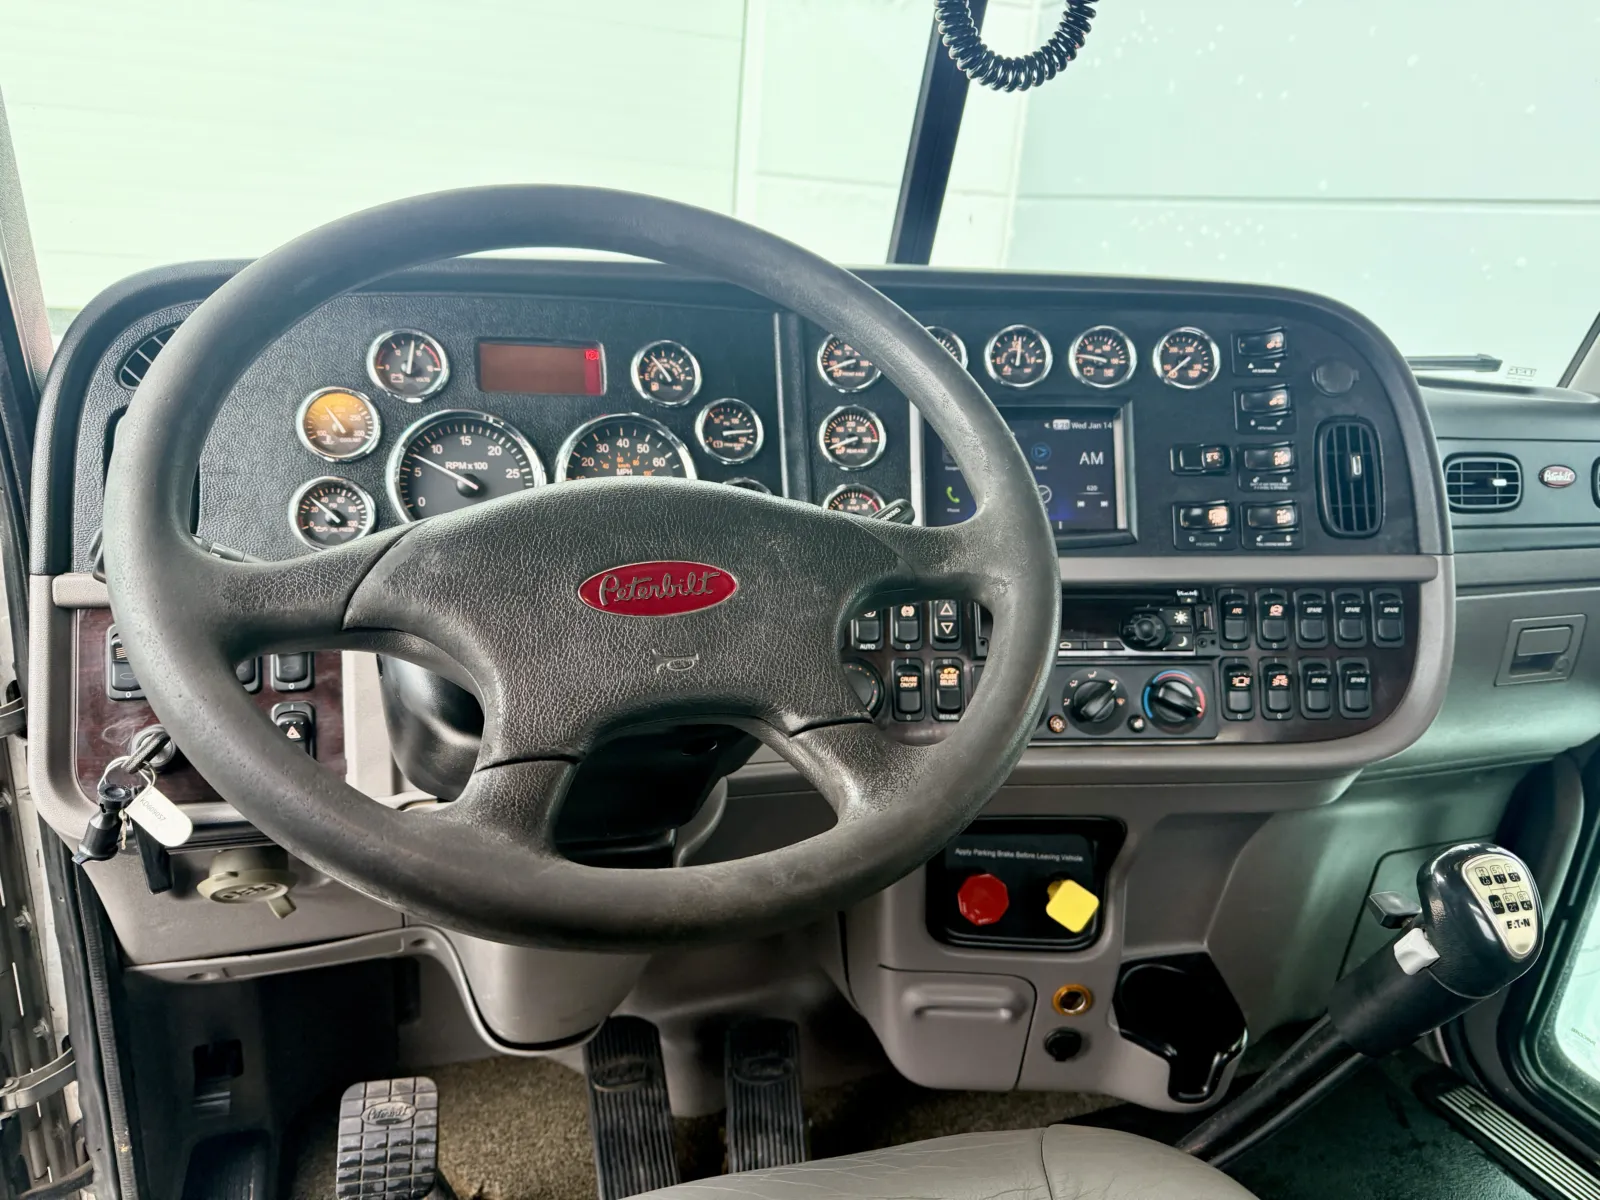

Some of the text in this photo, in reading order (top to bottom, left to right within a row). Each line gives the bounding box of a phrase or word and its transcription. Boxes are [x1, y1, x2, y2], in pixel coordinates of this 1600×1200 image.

[460, 436, 472, 446] 15
[616, 438, 630, 448] 40
[431, 444, 443, 454] 10
[487, 446, 502, 456] 20
[596, 443, 610, 453] 30
[637, 444, 650, 453] 50
[581, 457, 595, 467] 20
[652, 457, 666, 467] 60
[1080, 452, 1104, 465] AM
[445, 461, 467, 470] RPM
[414, 468, 422, 477] 5
[505, 468, 520, 479] 25
[616, 468, 633, 476] MPH
[418, 497, 426, 507] 0
[599, 572, 720, 606] Peterbilt
[1307, 606, 1323, 614] SPARE
[1345, 606, 1361, 614] SPARE
[1383, 606, 1400, 614] SPARE
[1350, 676, 1366, 684] SPARE
[955, 848, 1083, 862] Apply Parking Brake Before Leaving Vehicle
